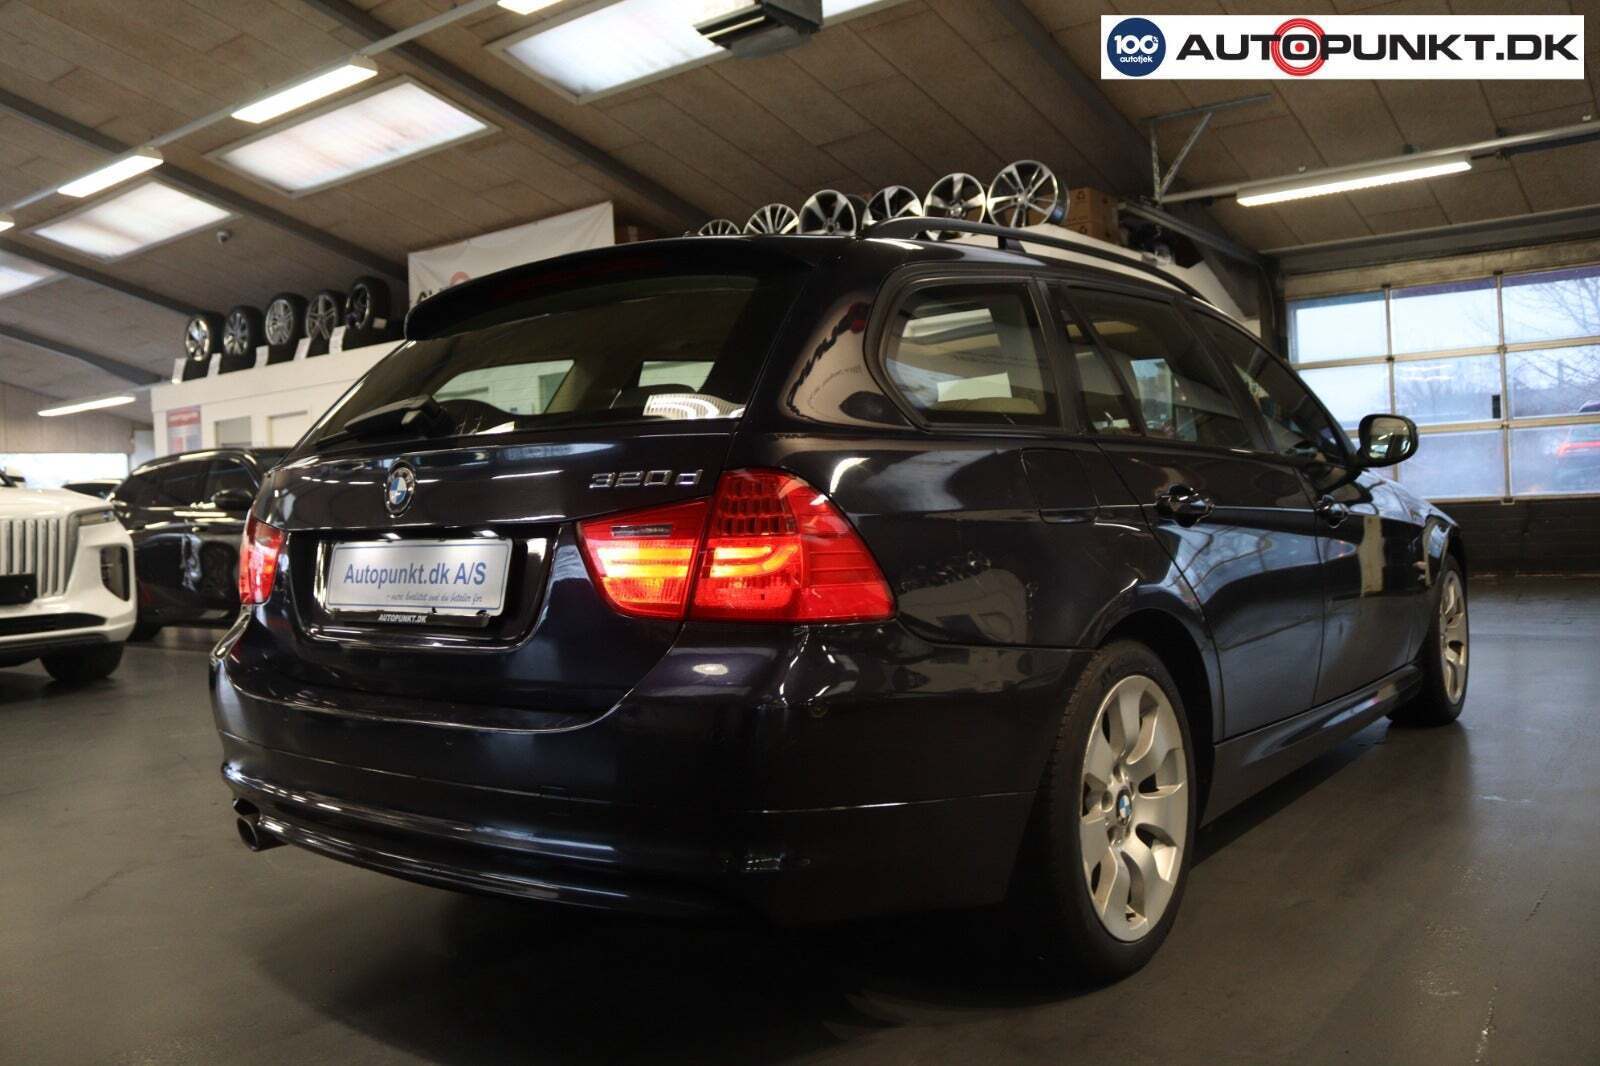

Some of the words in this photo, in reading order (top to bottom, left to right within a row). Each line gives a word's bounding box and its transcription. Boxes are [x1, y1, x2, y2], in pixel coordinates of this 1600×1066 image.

[344, 562, 450, 589] Autopunkt.dk
[453, 561, 487, 585] A/S
[378, 613, 427, 624] AUTOPUNKT.DK
